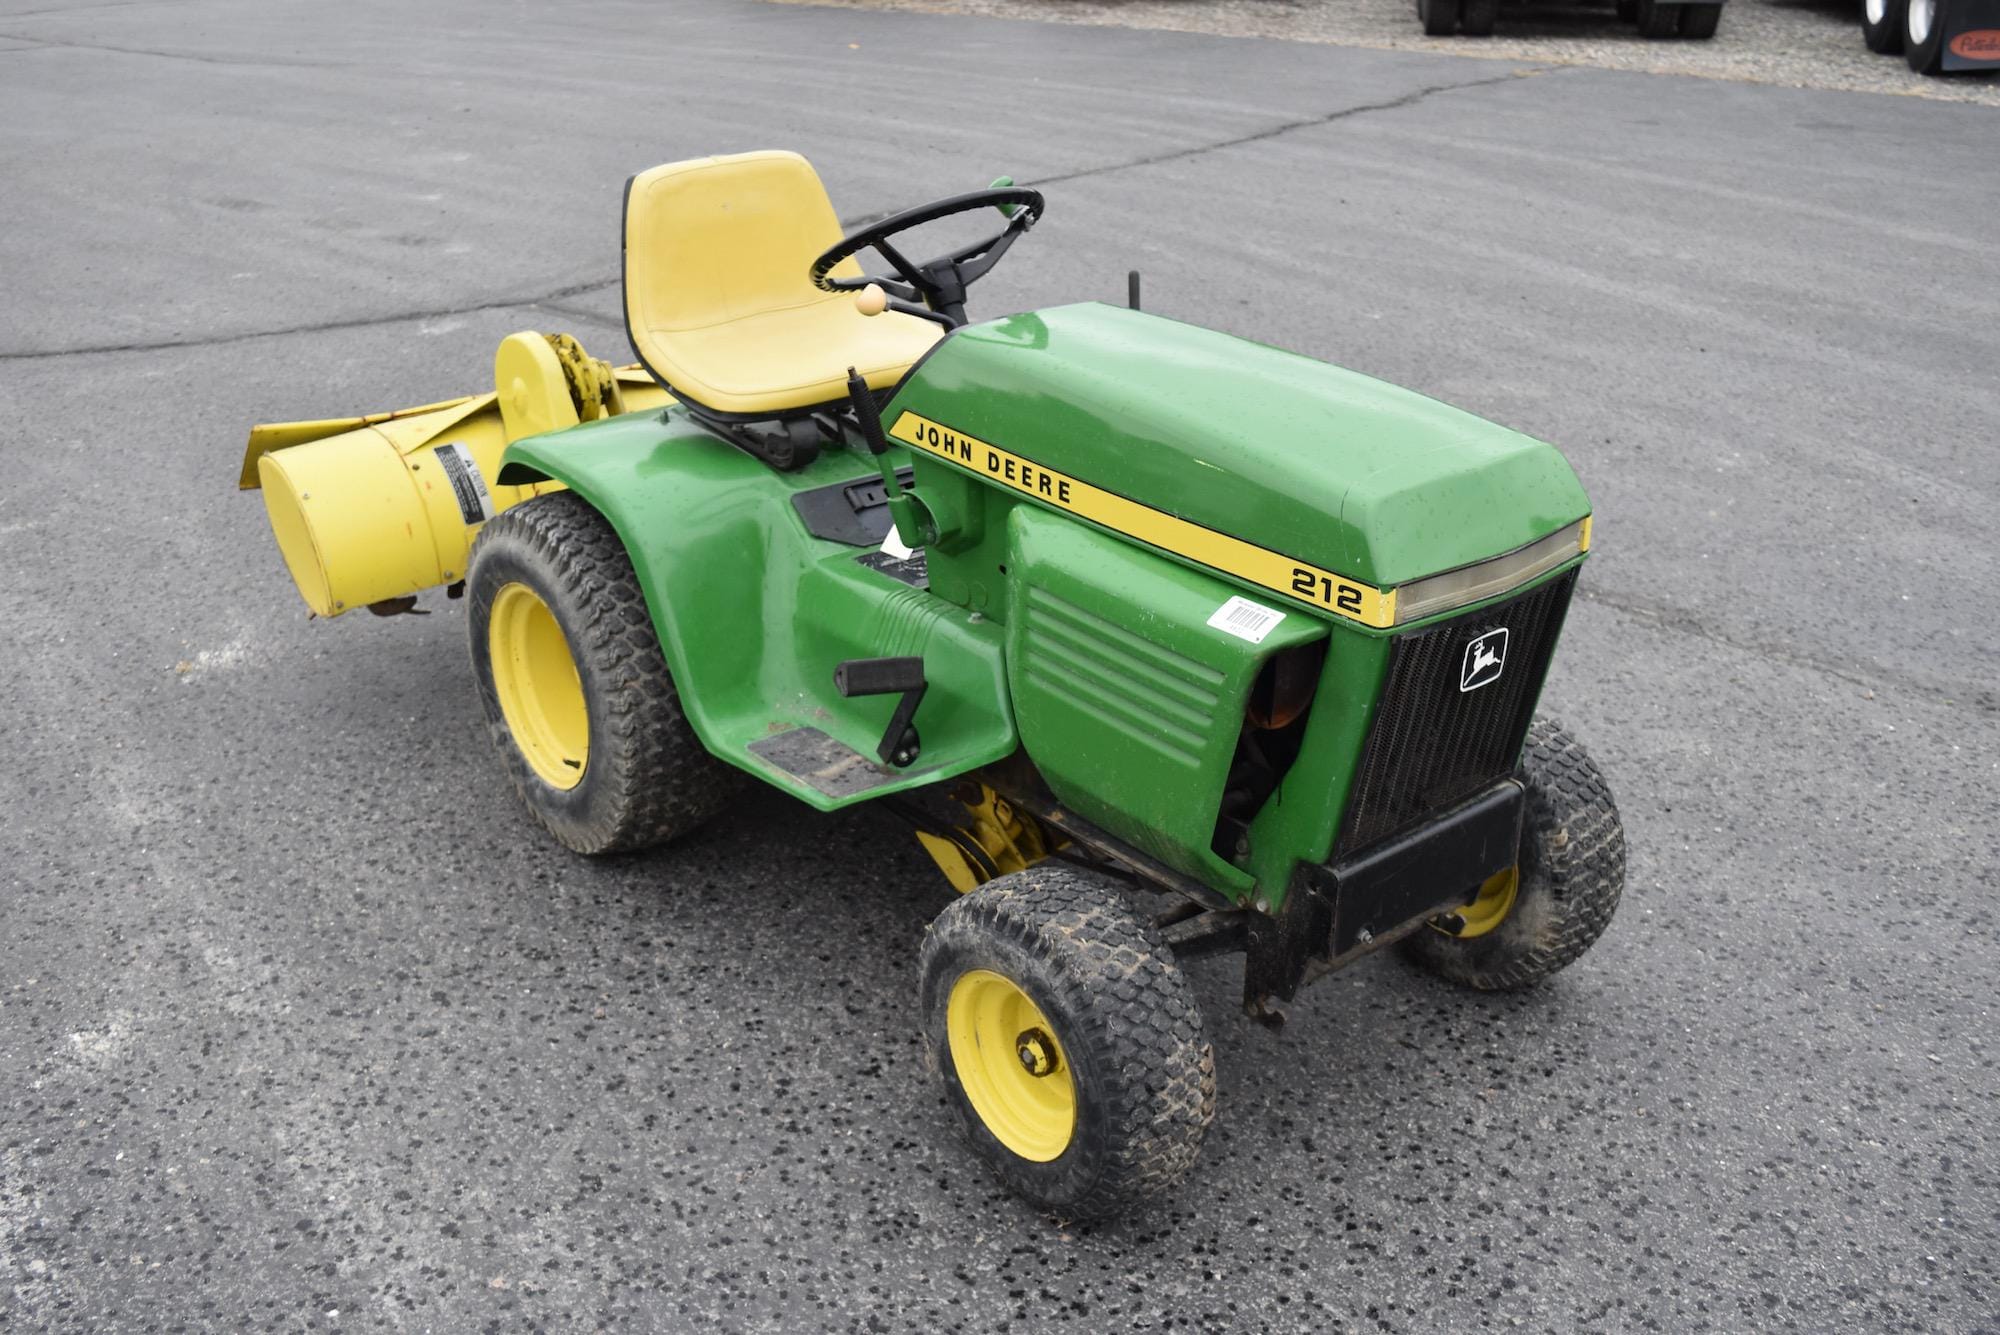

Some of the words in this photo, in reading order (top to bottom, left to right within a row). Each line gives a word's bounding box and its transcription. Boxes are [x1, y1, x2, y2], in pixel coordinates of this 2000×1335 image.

[916, 423, 972, 462] JOHN
[988, 451, 1071, 504] DEERE
[1292, 568, 1362, 615] 212
